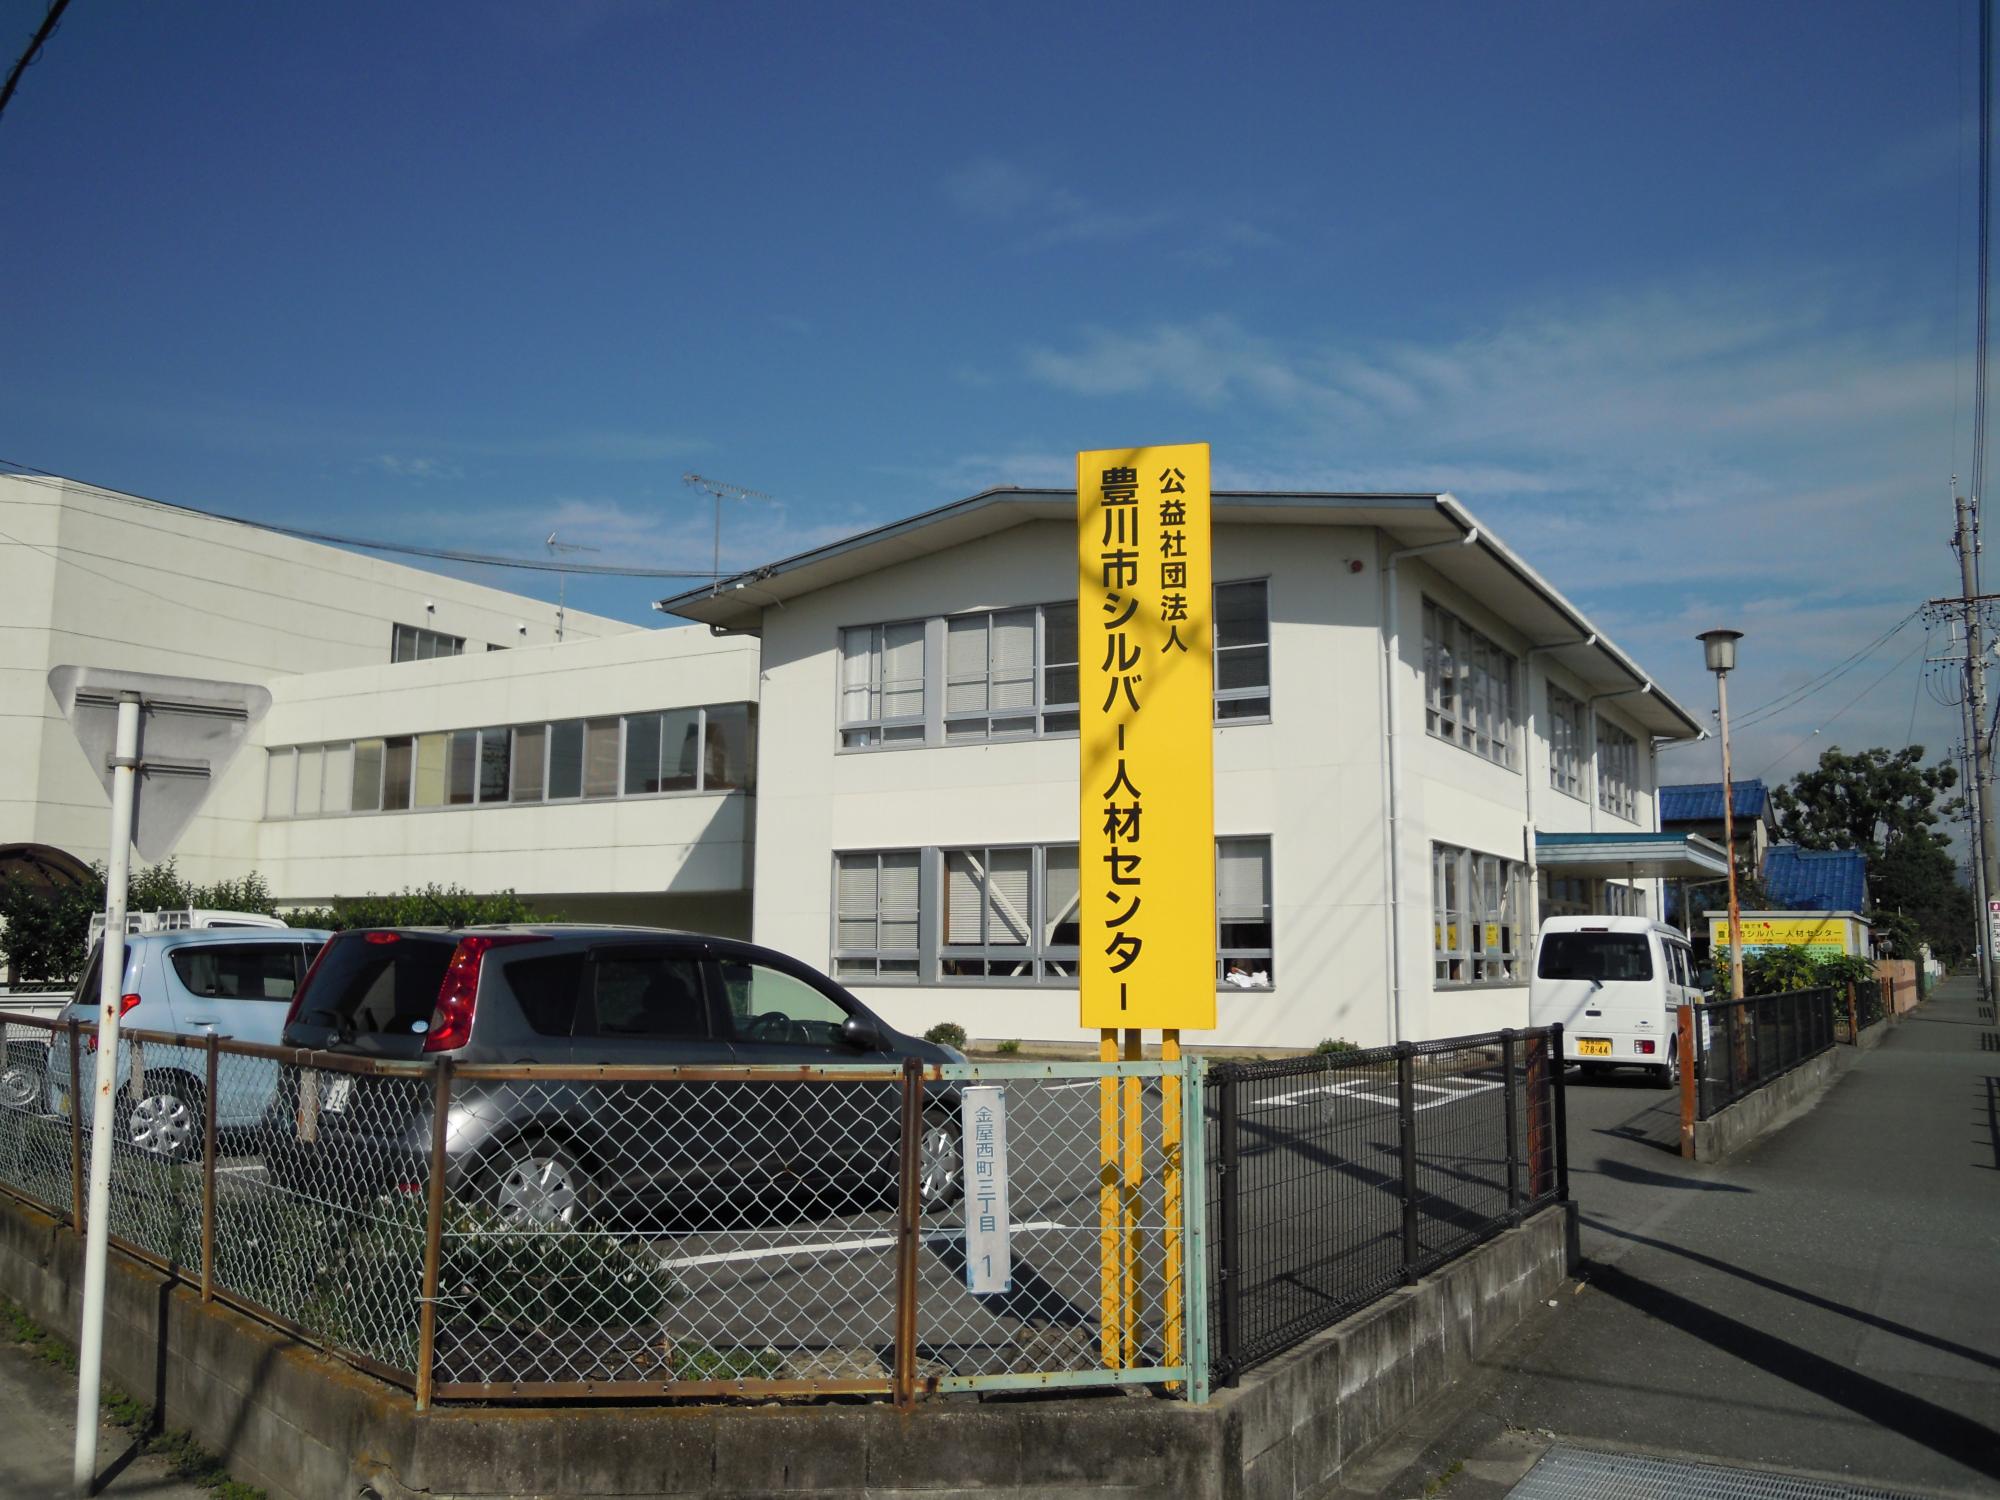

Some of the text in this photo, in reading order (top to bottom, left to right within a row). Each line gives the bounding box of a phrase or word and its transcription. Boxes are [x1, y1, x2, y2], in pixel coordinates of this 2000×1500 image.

[1159, 468, 1188, 654] 公益社団法人
[1100, 468, 1143, 1011] 豊川市シルバー人材センター
[975, 1105, 997, 1278] 金屋西町三丁目 1
